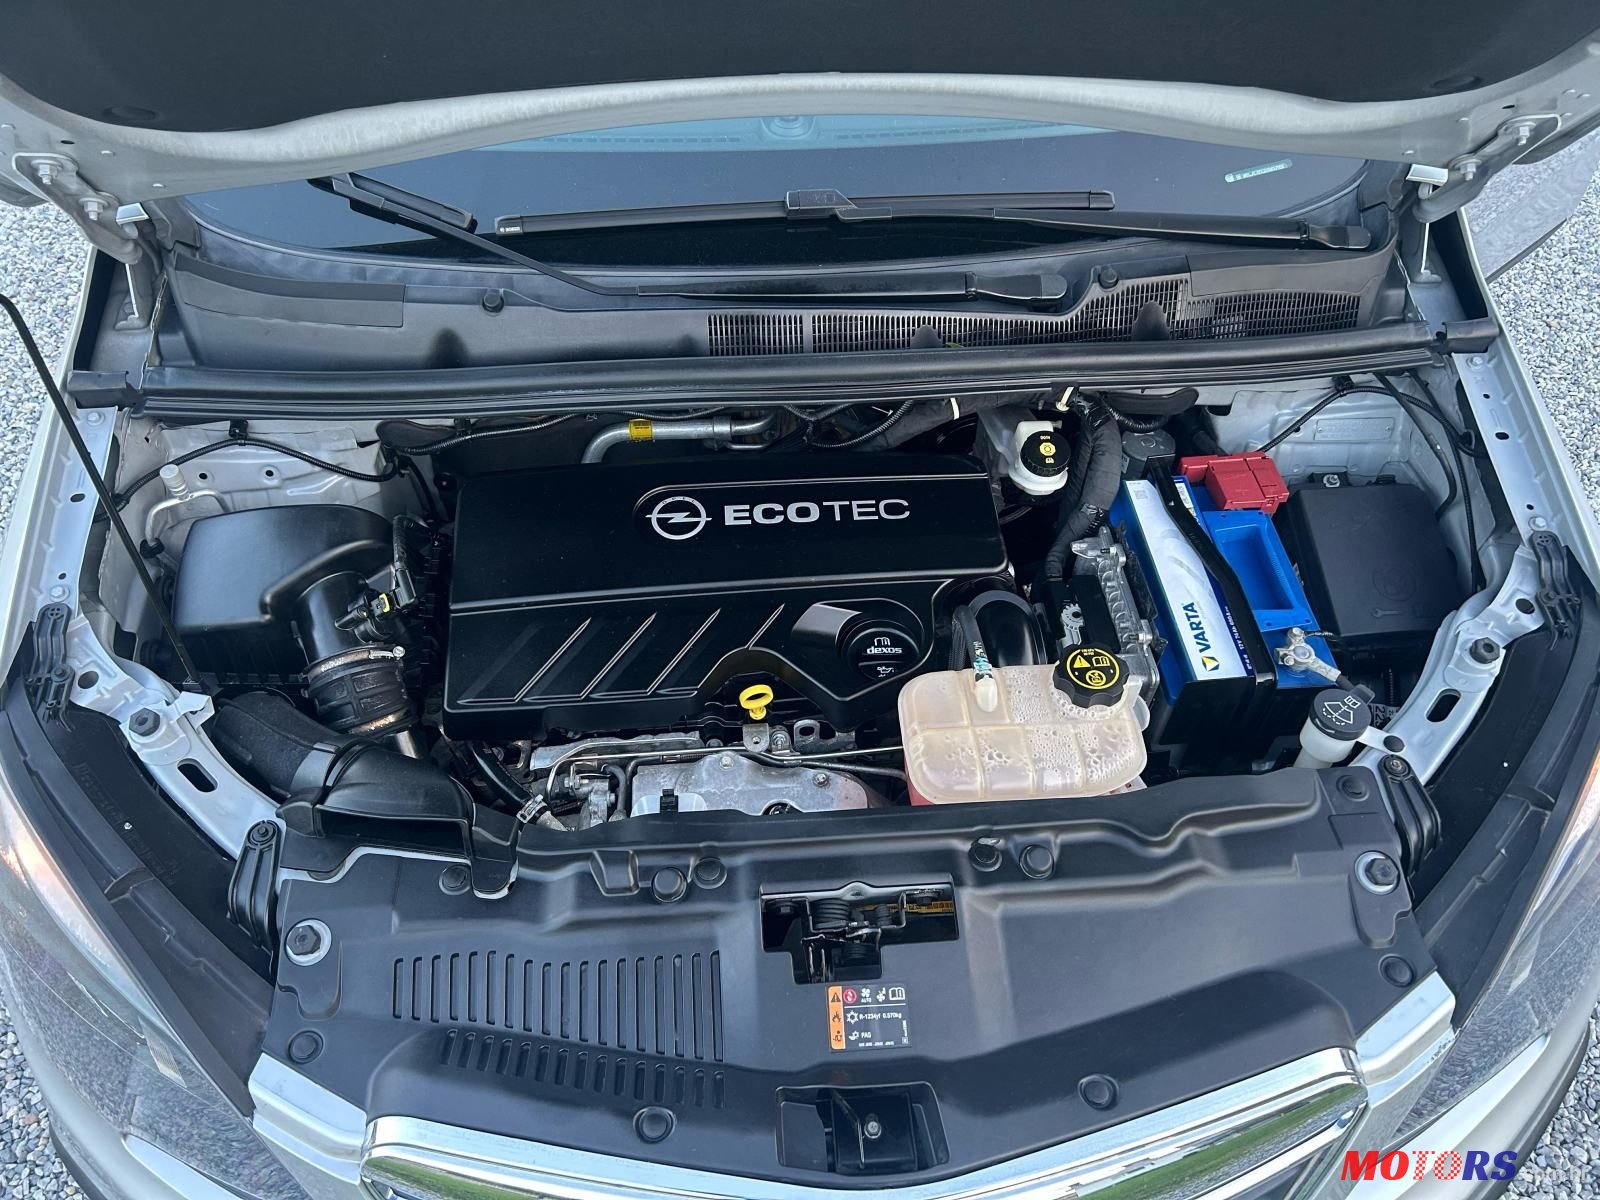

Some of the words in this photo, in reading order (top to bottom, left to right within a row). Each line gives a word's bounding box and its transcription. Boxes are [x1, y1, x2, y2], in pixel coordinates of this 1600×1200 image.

[723, 499, 911, 526] ECOTEC
[1182, 602, 1212, 653] VARTA
[866, 646, 903, 654] dexos
